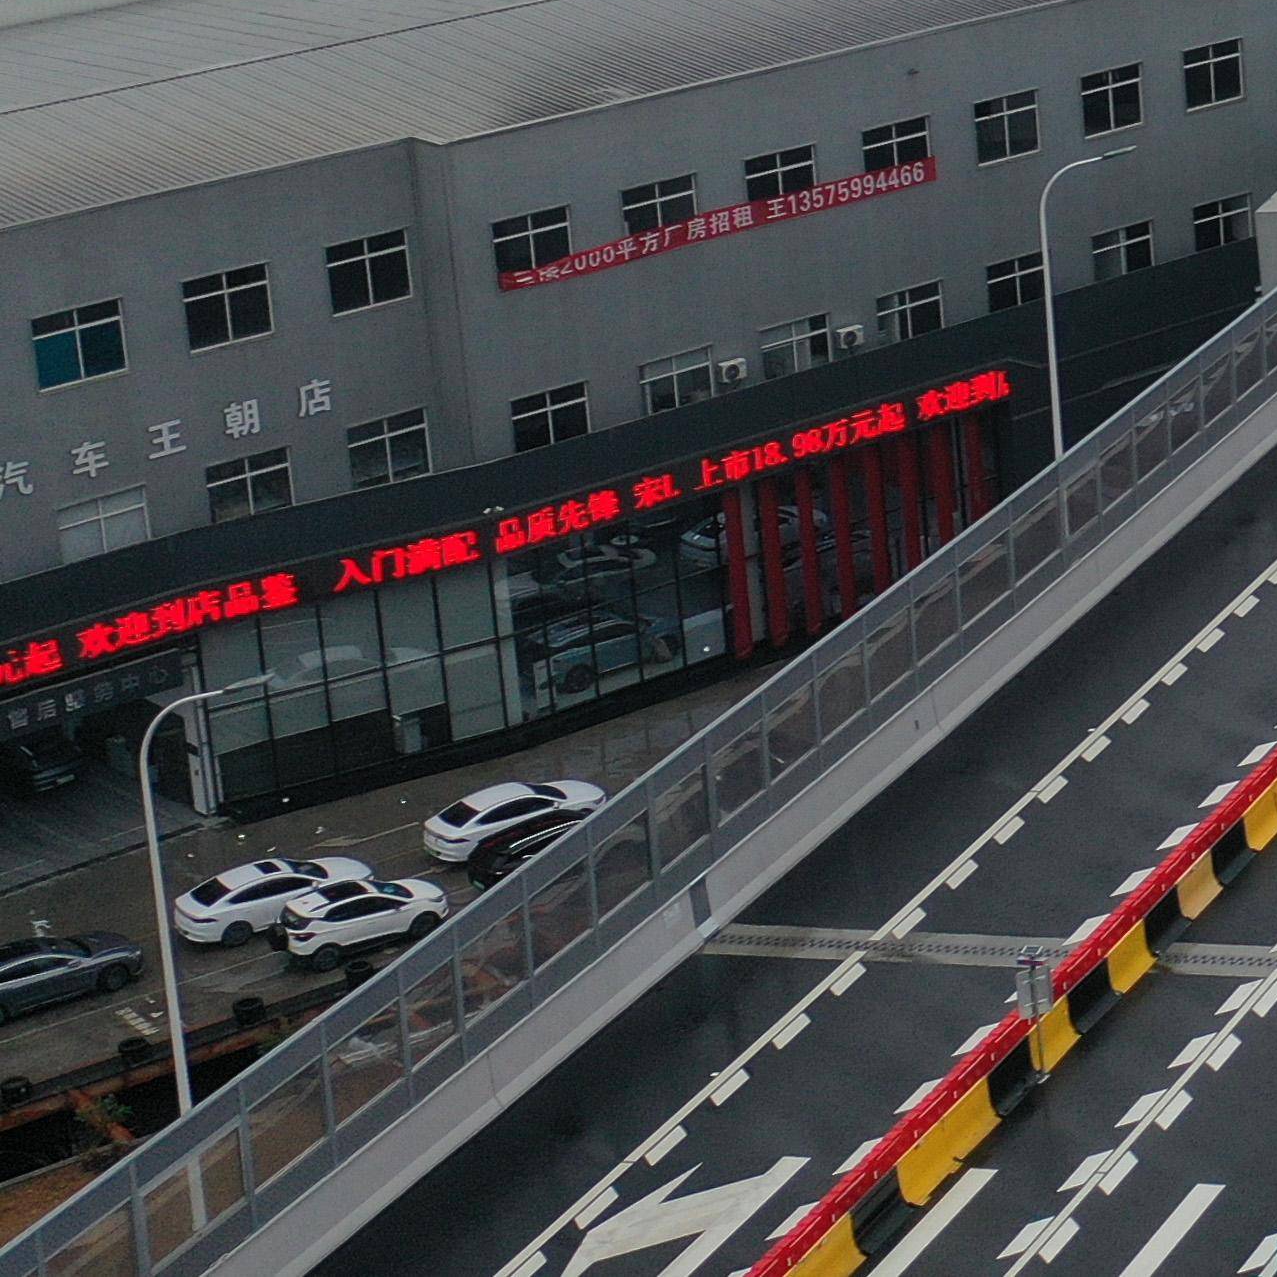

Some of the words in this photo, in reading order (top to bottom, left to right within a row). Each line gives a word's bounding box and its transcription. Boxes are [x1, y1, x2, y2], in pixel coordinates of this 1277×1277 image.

[765, 160, 926, 220] 王13575994466
[75, 572, 301, 659] 欢迎到店品鉴
[494, 489, 621, 554] 品质先锋
